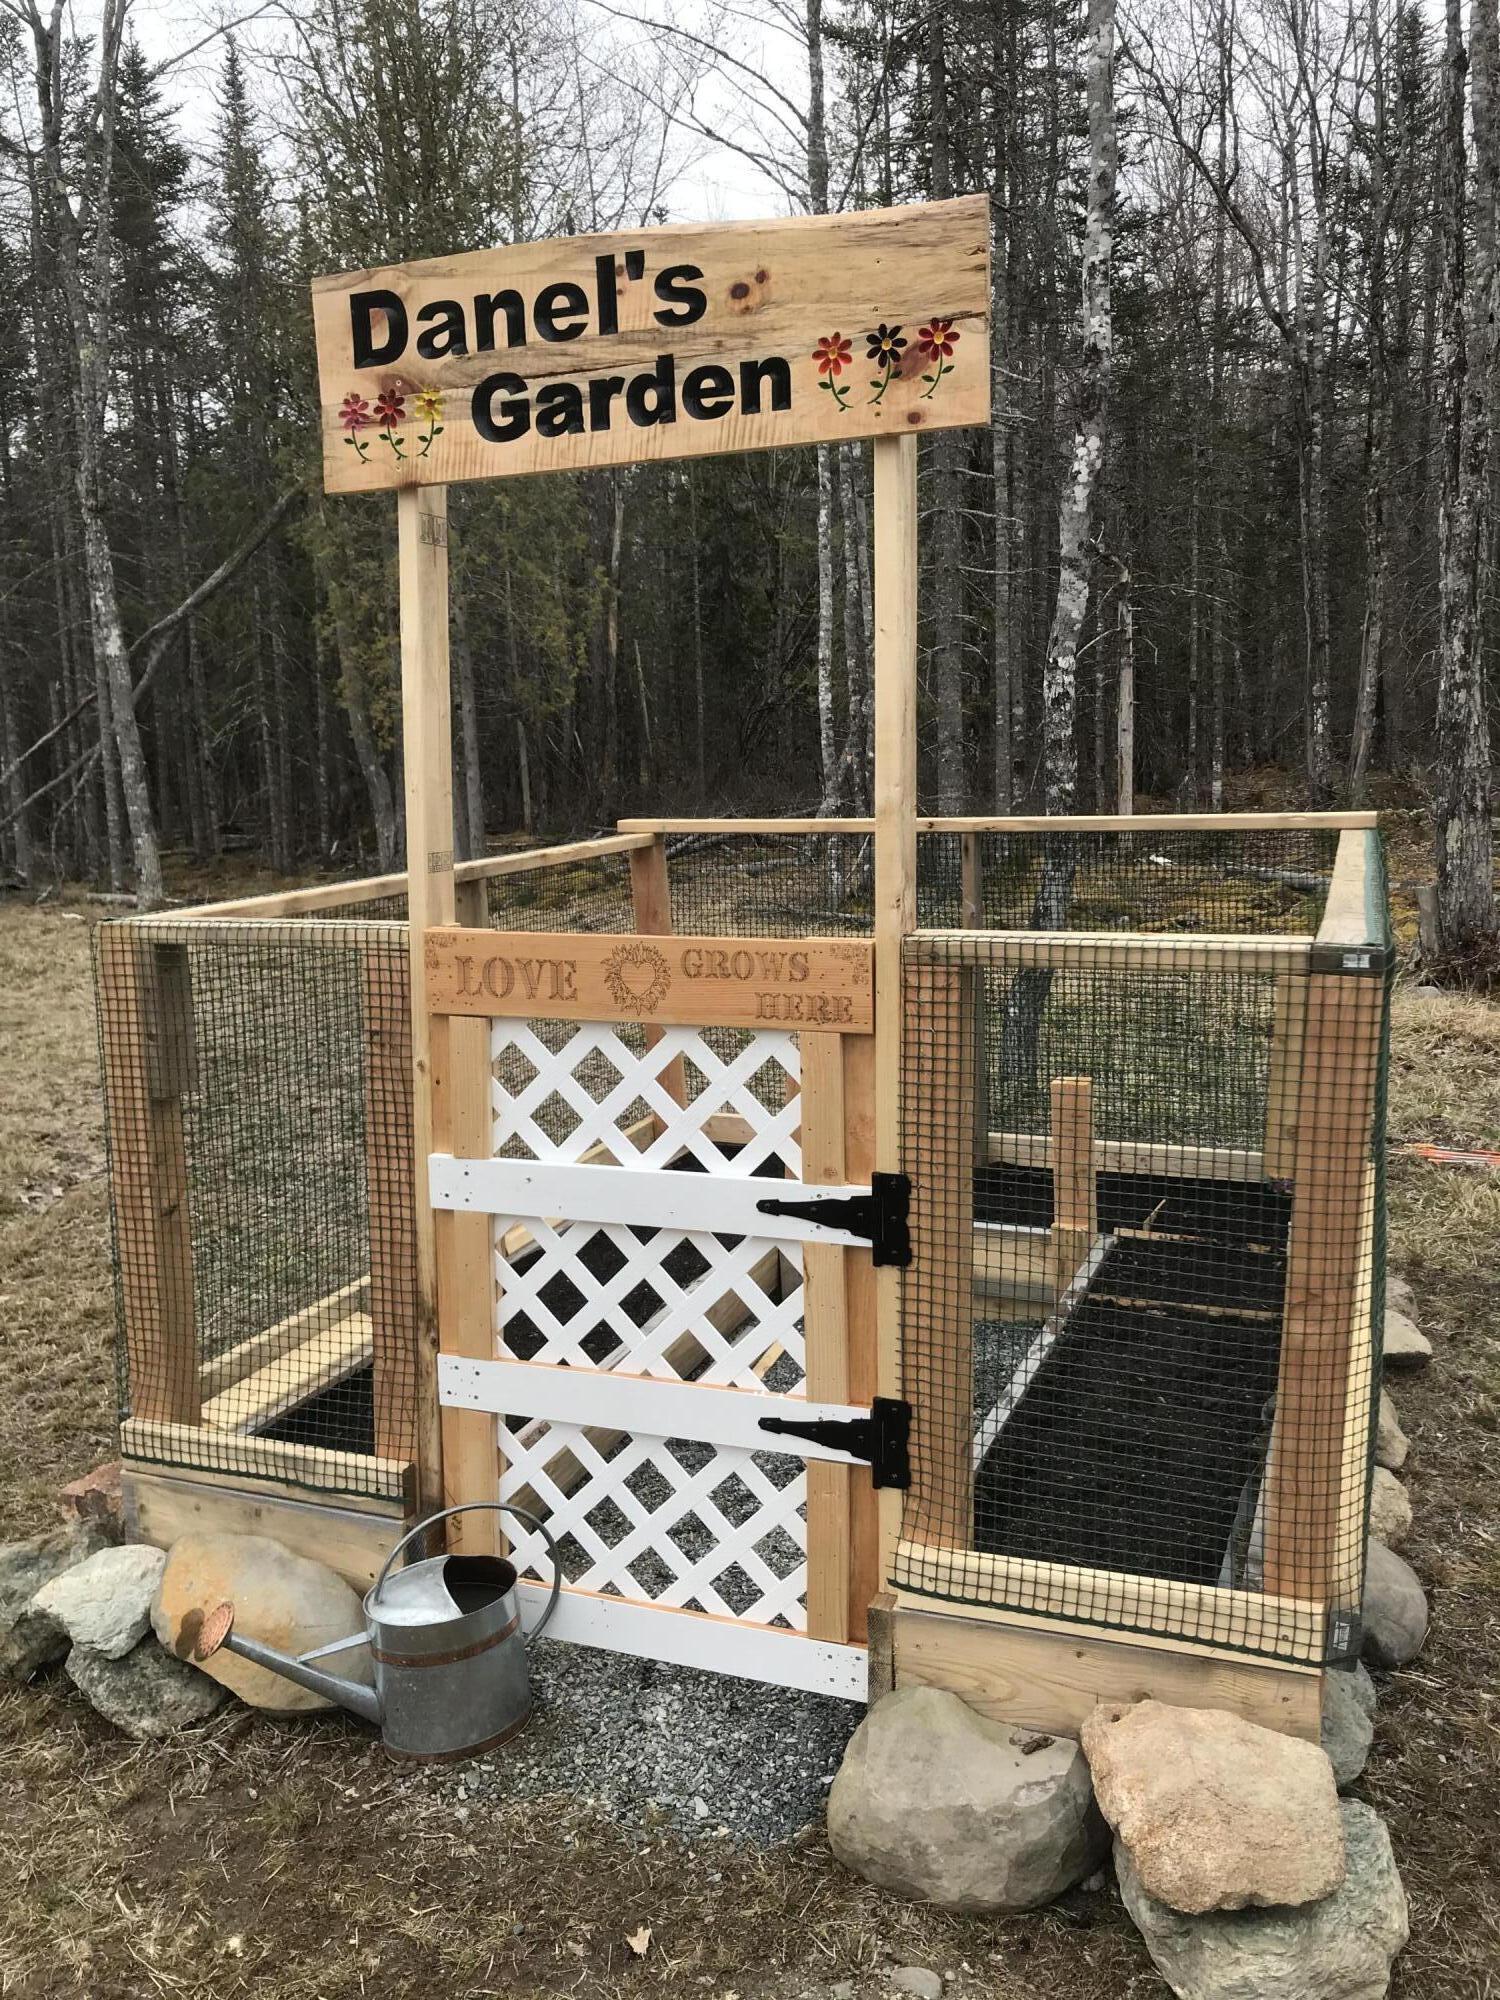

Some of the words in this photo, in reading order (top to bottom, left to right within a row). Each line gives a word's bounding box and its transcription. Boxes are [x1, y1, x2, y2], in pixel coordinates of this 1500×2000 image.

[349, 249, 708, 369] Danel's
[472, 355, 792, 443] Garden
[455, 956, 578, 1000] LOVE
[681, 949, 810, 983] GROWS
[756, 992, 853, 1024] HERE
